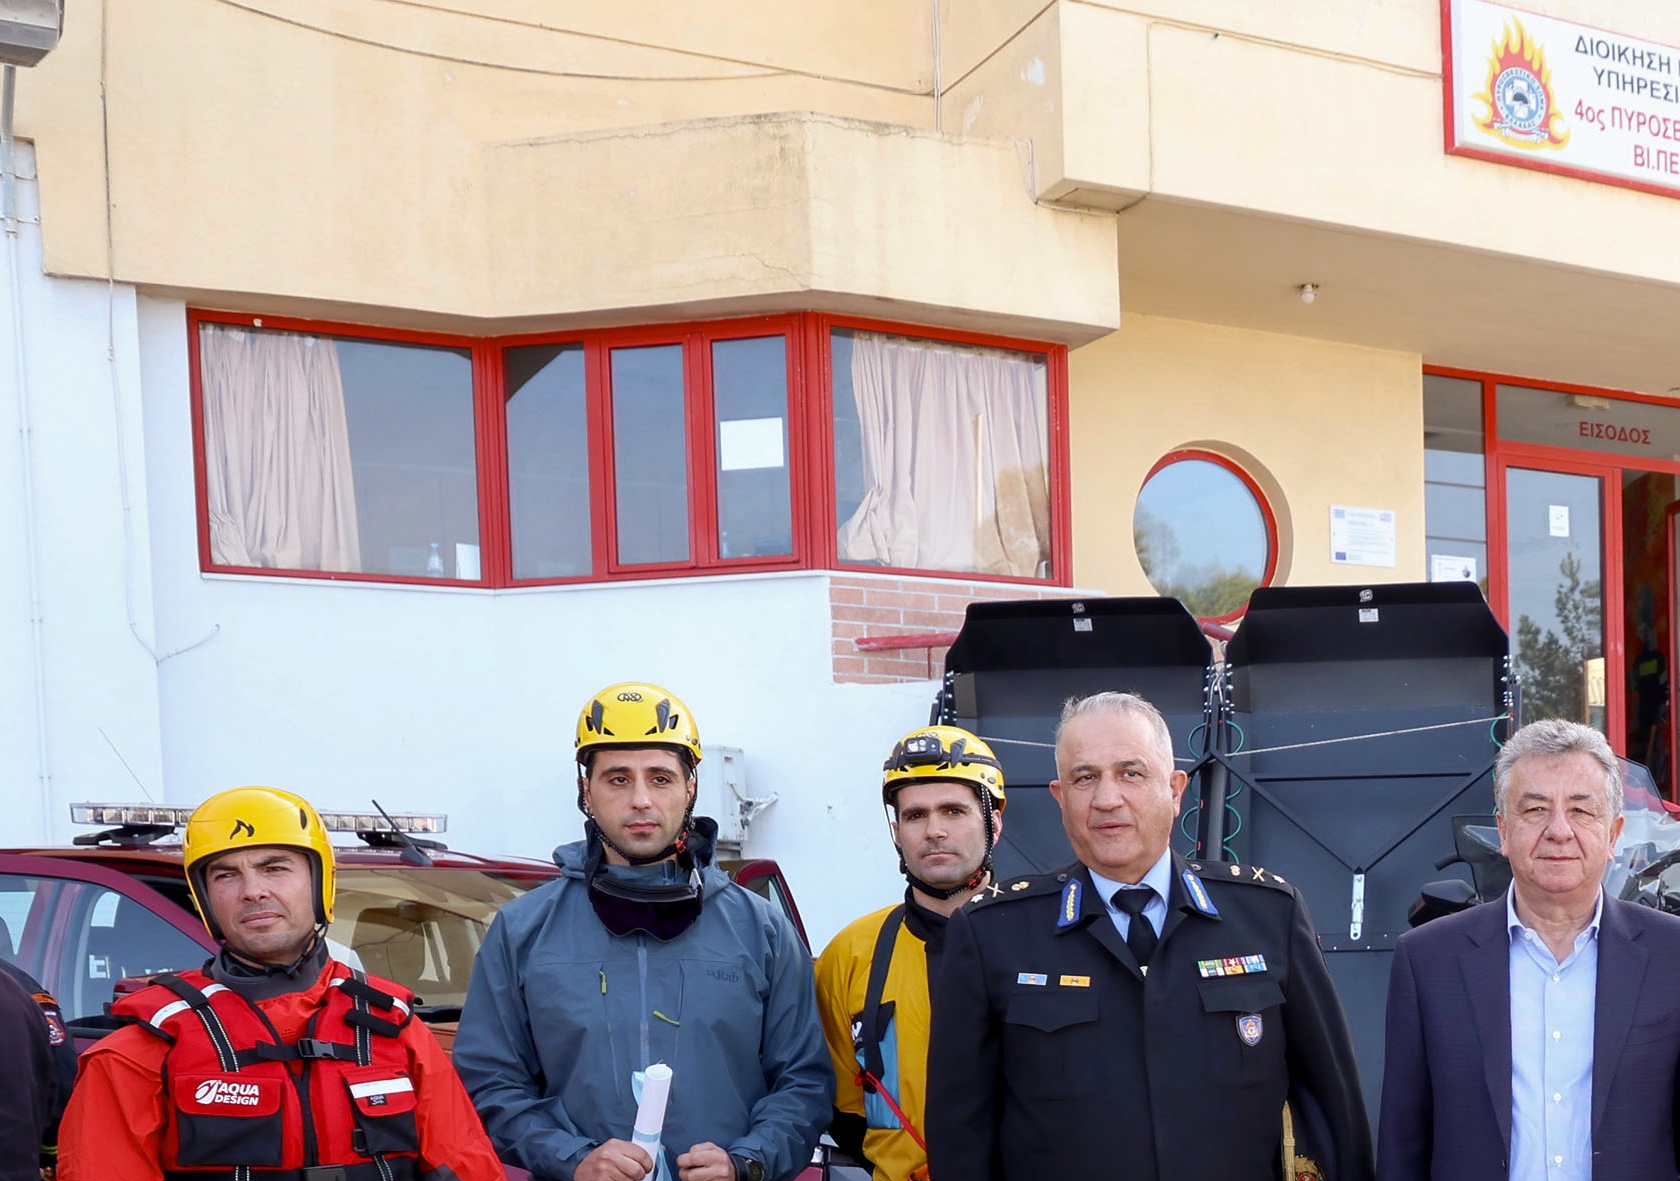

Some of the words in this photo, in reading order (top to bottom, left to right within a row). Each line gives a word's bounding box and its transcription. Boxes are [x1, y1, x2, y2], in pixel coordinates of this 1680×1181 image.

[1575, 35, 1671, 75] ΔΙΟΙΚΗΣΗ
[1575, 98, 1606, 132] 4ος
[1579, 421, 1651, 445] ΕΙΣΟΔΟΣ
[214, 1094, 259, 1106] DESIGN
[217, 1082, 260, 1096] AQUA
